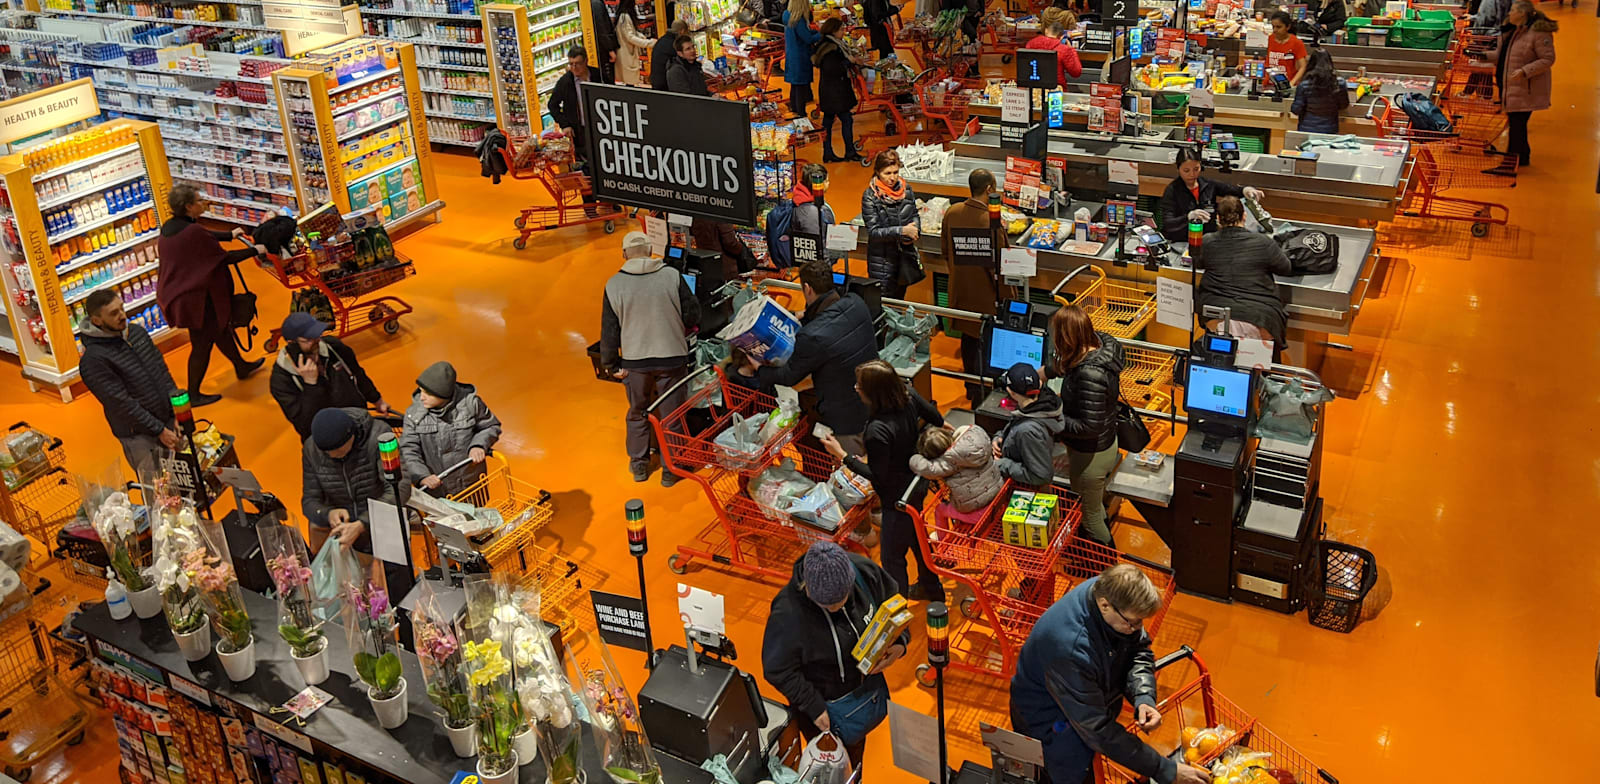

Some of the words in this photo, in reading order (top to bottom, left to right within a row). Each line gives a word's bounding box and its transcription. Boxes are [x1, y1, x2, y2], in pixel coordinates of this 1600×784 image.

[1113, 1, 1125, 19] 2
[1029, 60, 1040, 80] 1
[4, 109, 37, 126] HEALTH
[38, 107, 45, 115] &
[47, 96, 79, 113] BEAUTY
[595, 98, 648, 139] SELF
[322, 123, 335, 154] BEAUTY
[599, 137, 740, 194] CHECKOUTS
[331, 166, 342, 194] HEALTH
[603, 179, 616, 189] NO
[617, 182, 642, 194] CASH.
[643, 185, 674, 198] CREDIT
[675, 191, 682, 199] &
[683, 192, 708, 203] DEBIT
[709, 197, 734, 209] ONLY.
[29, 230, 46, 267] BEAUTY
[793, 236, 817, 250] BEER
[793, 248, 818, 261] LANE
[40, 269, 49, 277] &
[42, 280, 59, 315] HEALTH
[595, 604, 613, 615] WINE
[614, 607, 628, 618] AND
[629, 610, 644, 621] BEE
[598, 613, 630, 627] PURCHASE
[630, 619, 645, 629] LAN
